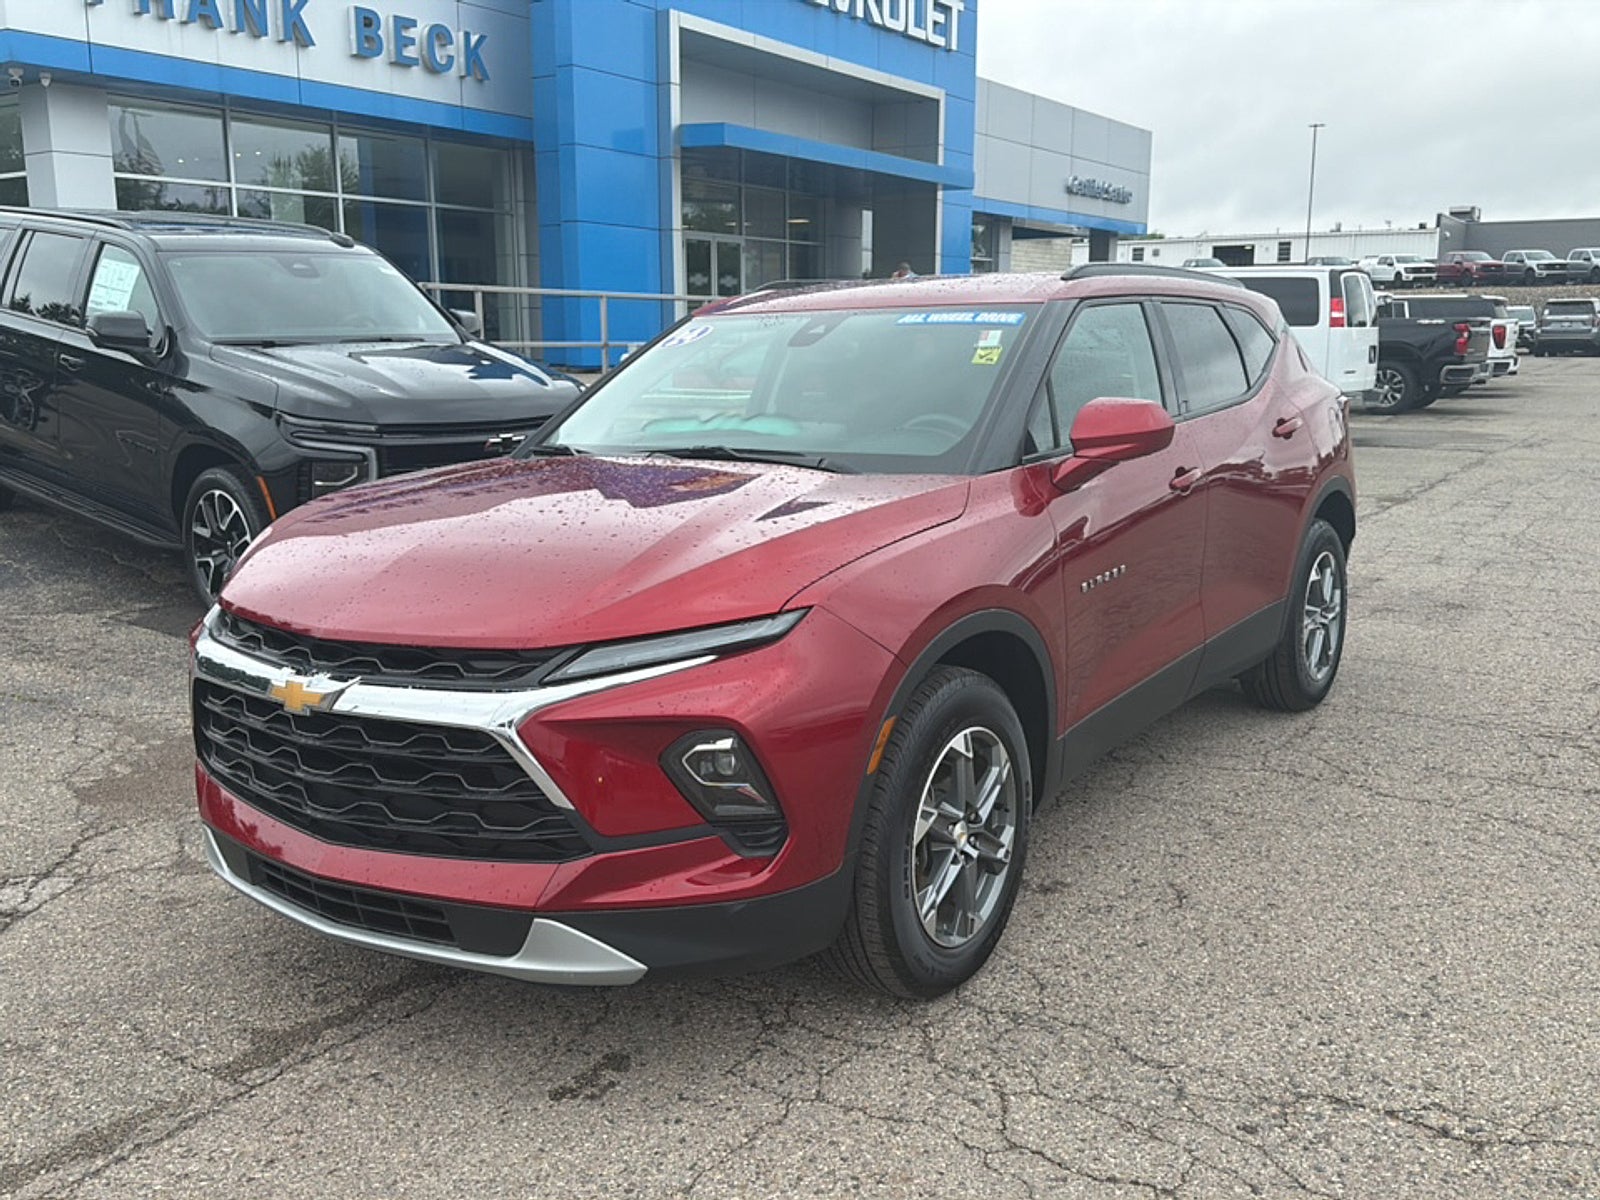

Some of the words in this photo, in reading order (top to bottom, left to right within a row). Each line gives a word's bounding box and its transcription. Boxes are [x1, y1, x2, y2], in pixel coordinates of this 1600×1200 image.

[349, 5, 490, 81] BECK
[926, 311, 975, 324] WHEEL
[975, 311, 1022, 325] DRIVE
